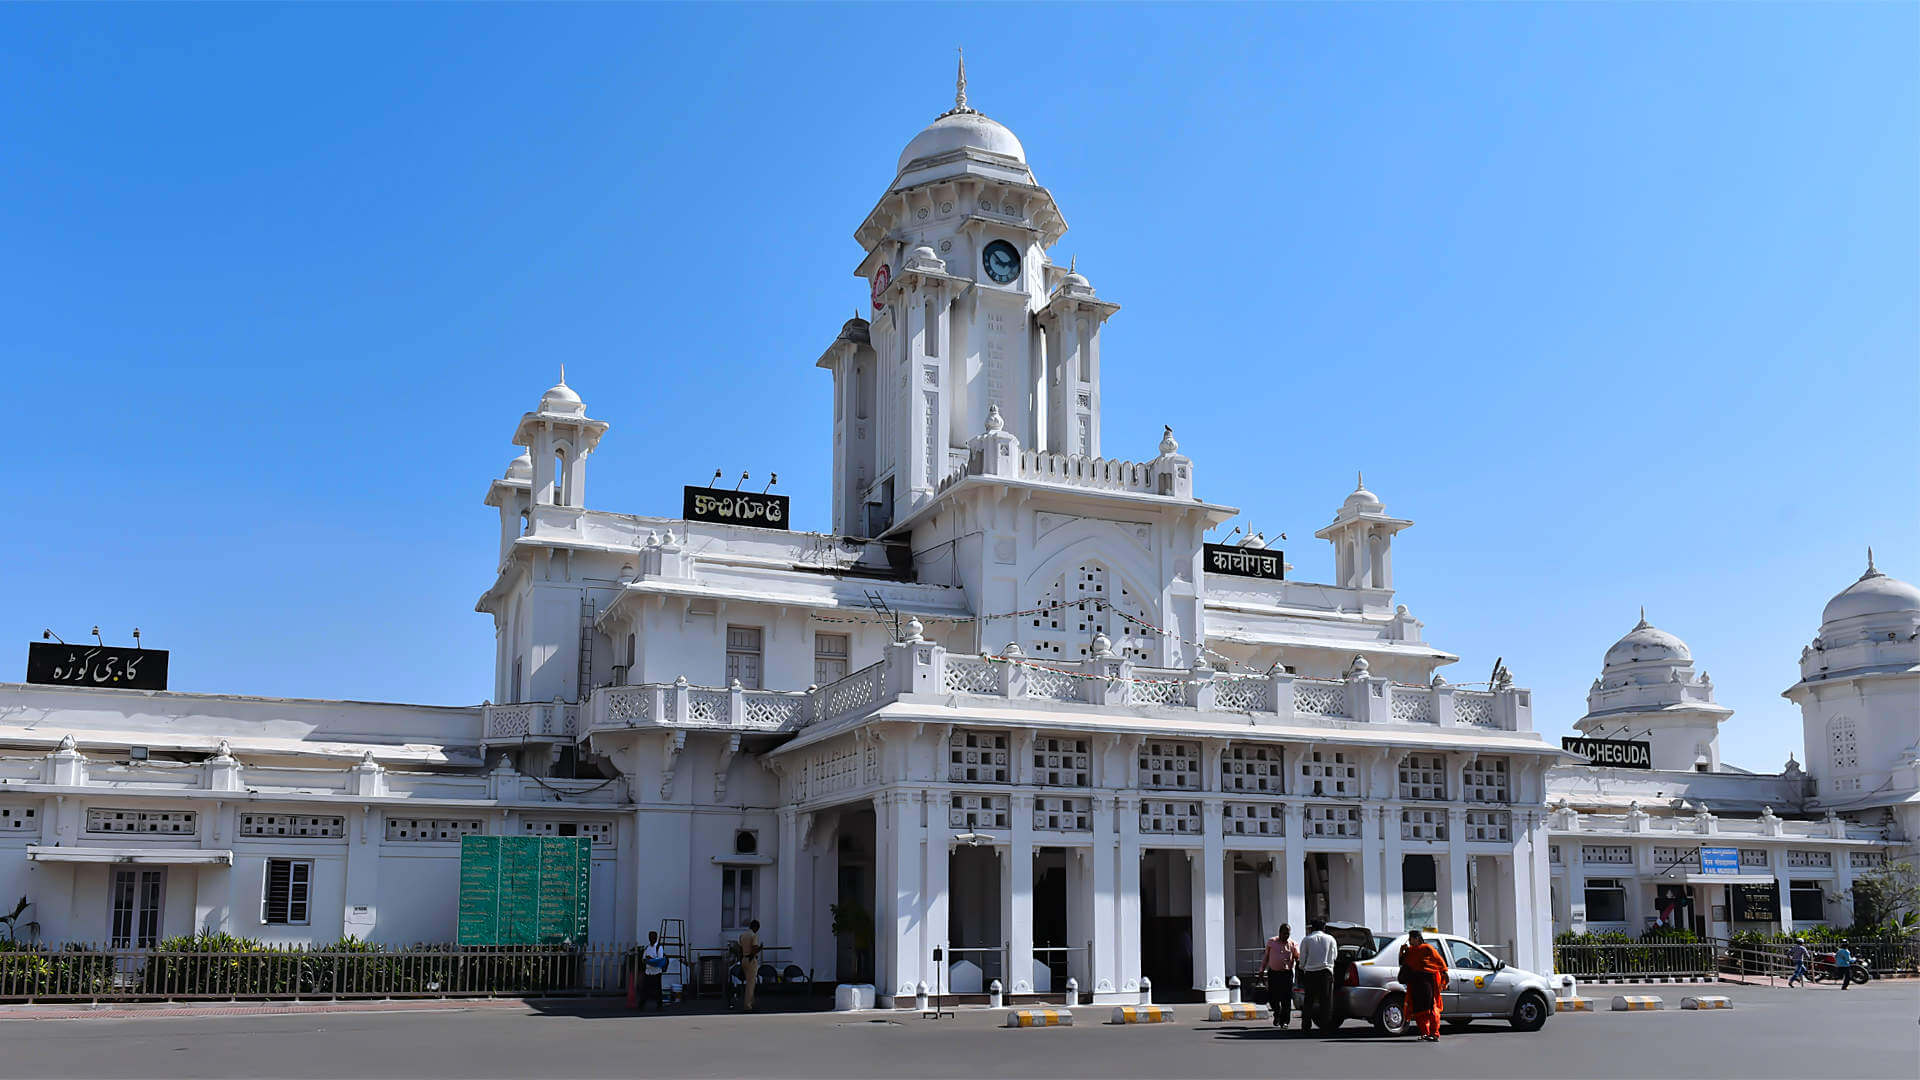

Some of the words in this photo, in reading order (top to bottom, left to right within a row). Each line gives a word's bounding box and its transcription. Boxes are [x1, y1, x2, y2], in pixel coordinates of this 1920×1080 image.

[694, 494, 782, 522] కాచిగూడ
[1212, 548, 1278, 577] काचीगुडा
[1567, 741, 1649, 765] KACHEGUDA
